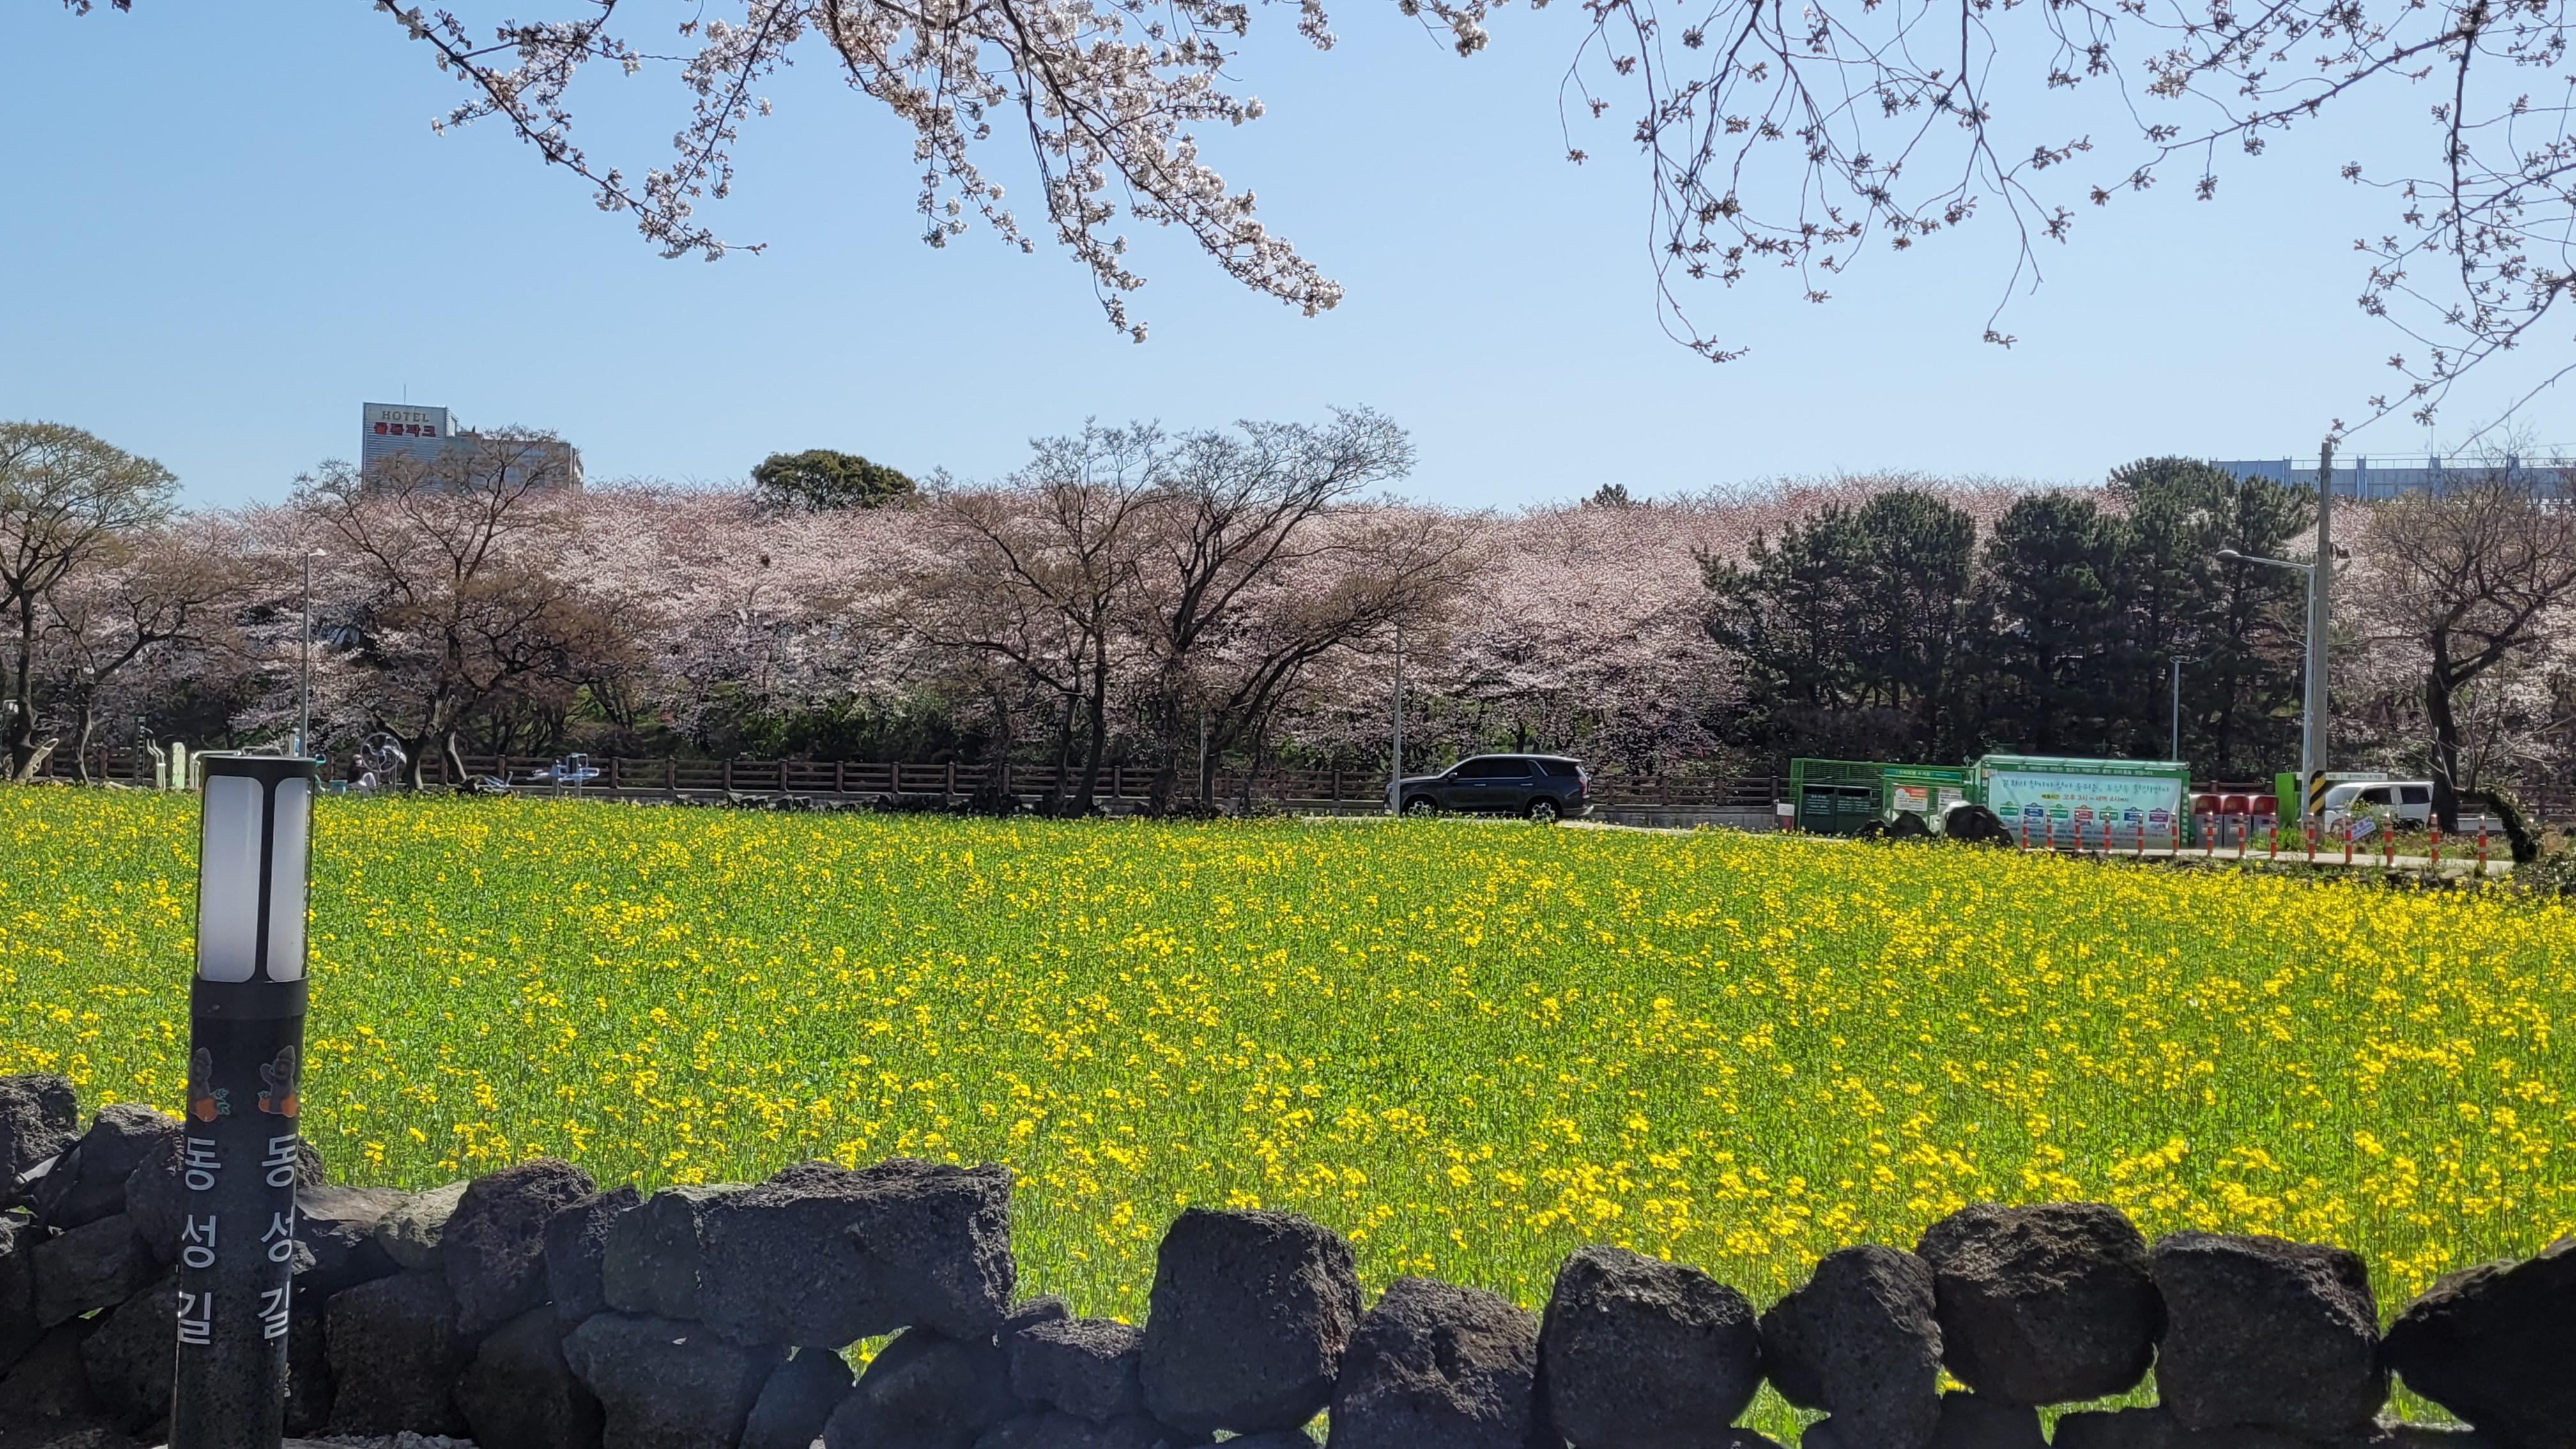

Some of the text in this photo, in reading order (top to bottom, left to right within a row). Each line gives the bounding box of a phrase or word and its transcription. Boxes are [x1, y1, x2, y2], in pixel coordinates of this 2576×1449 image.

[374, 422, 436, 438] 파크
[382, 411, 429, 422] HOTEL
[178, 1137, 222, 1346] 동성길
[258, 1133, 298, 1340] 동성길
